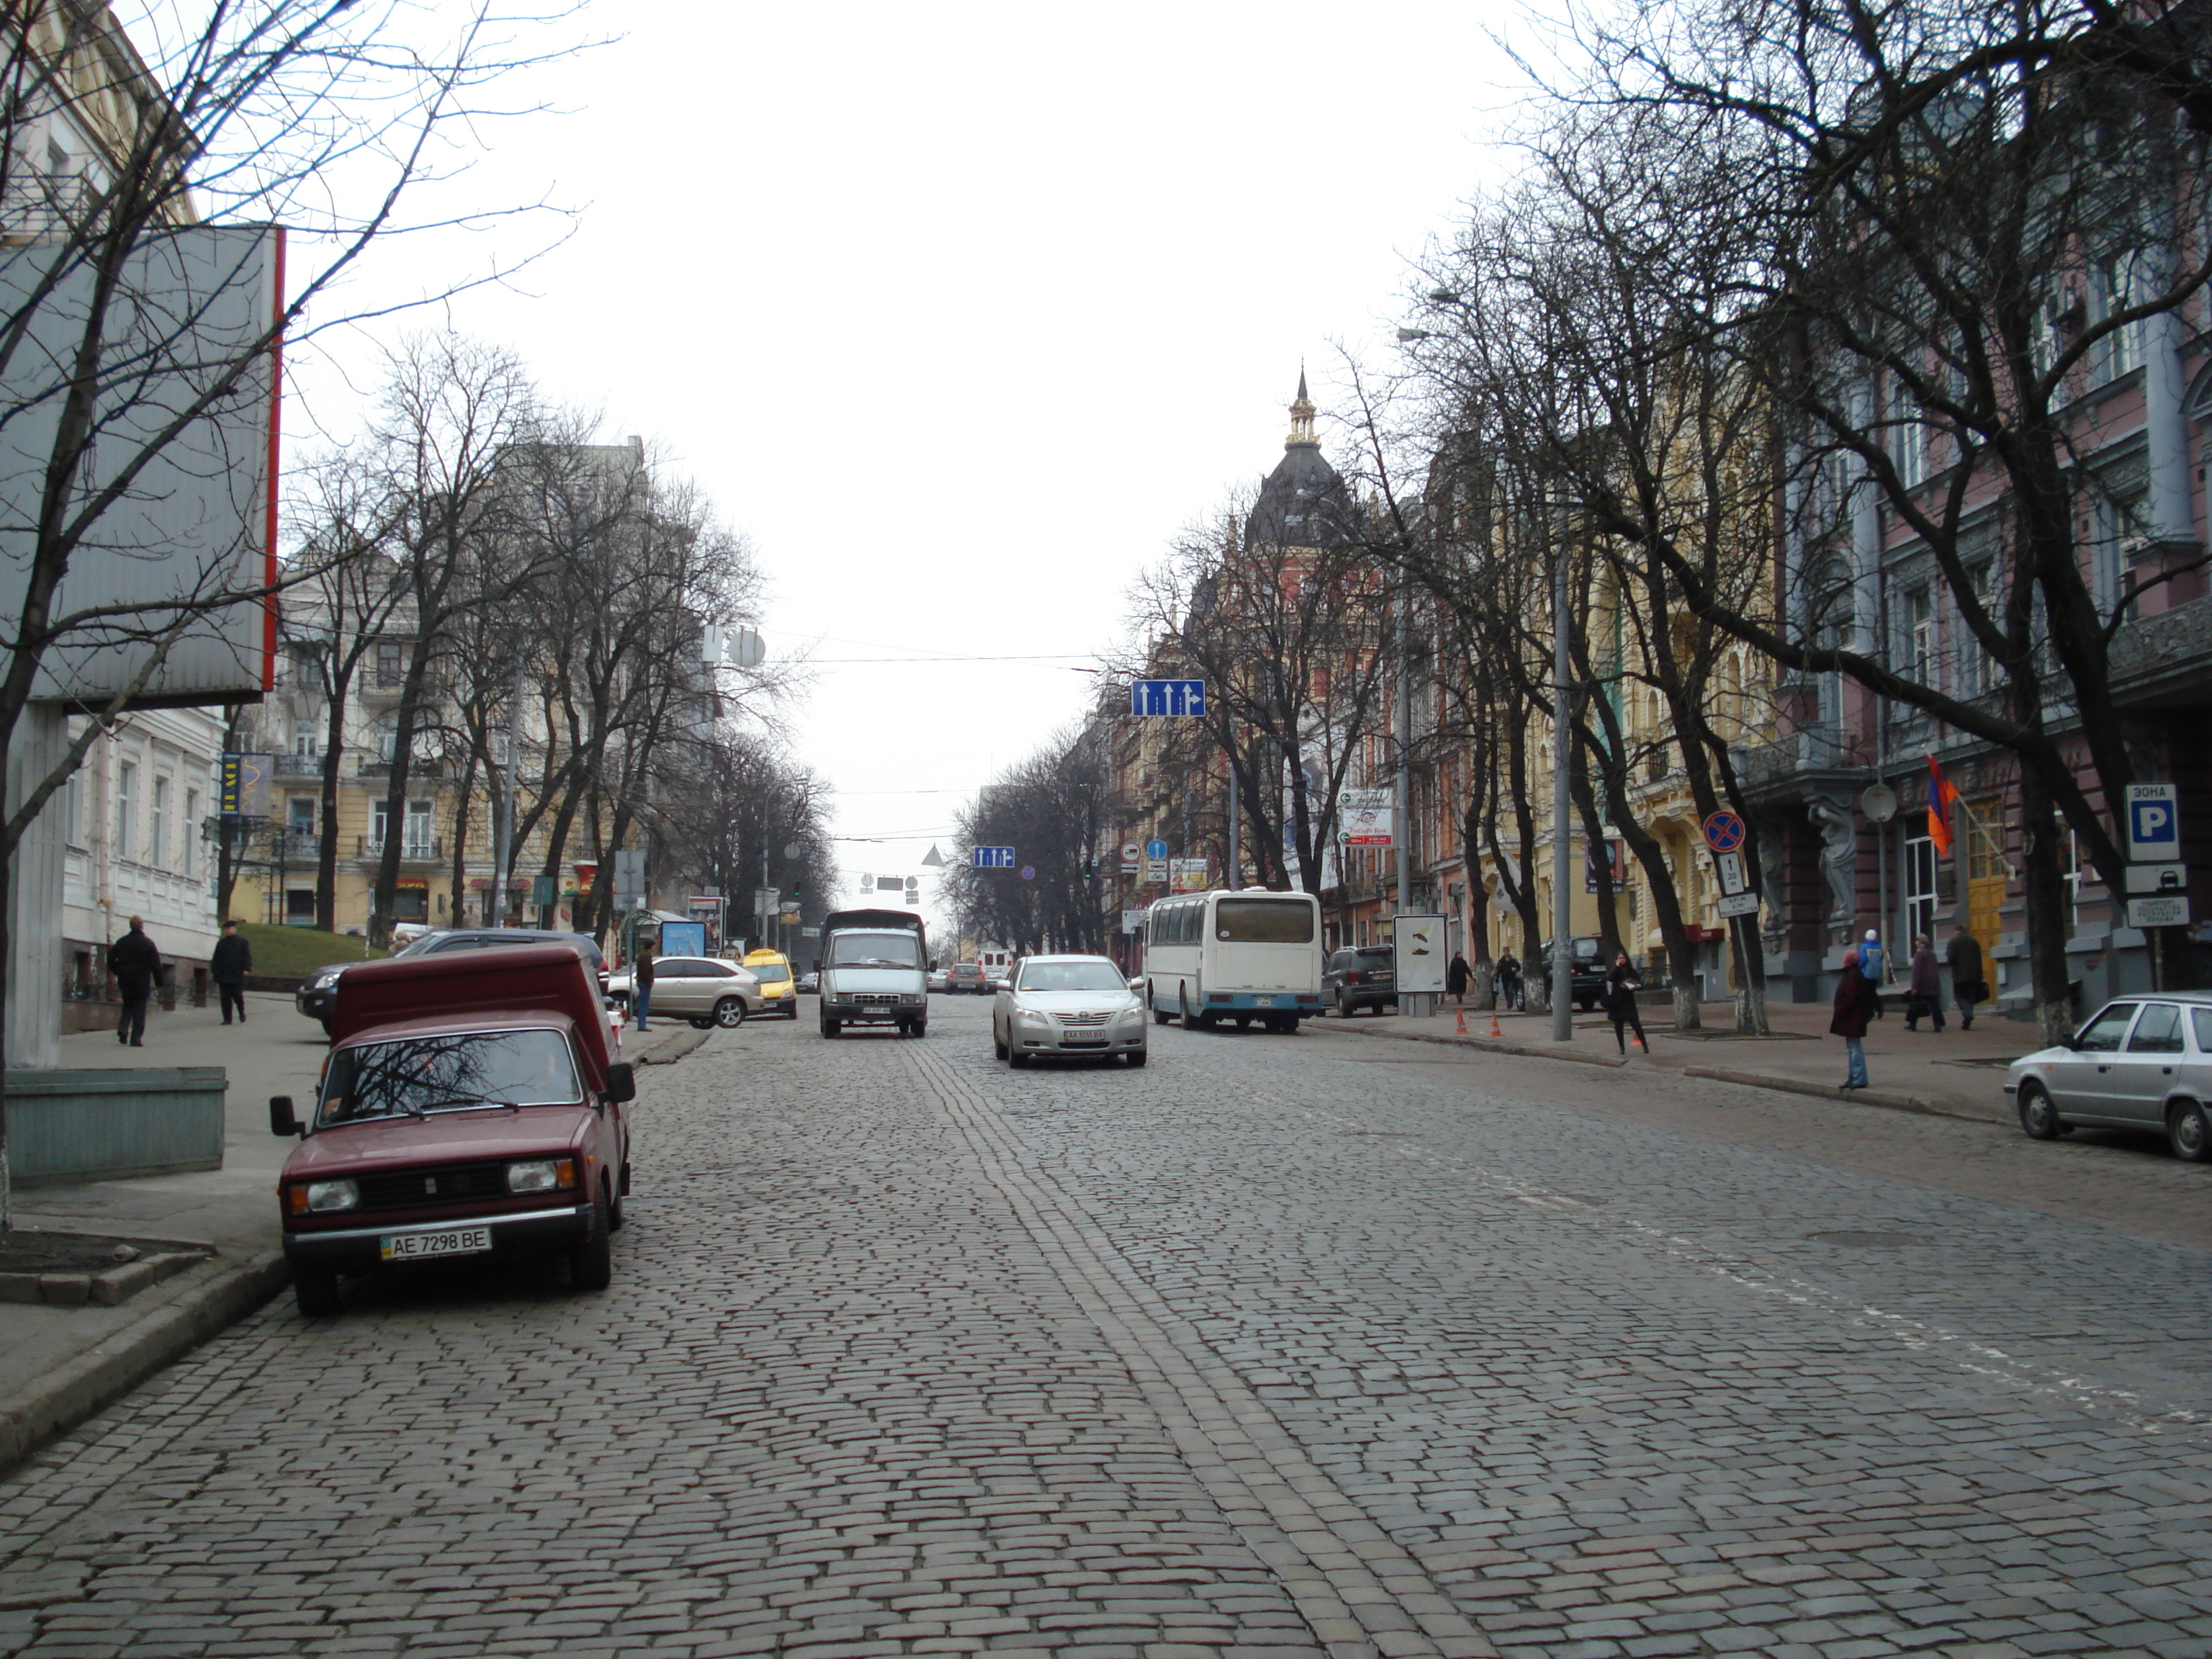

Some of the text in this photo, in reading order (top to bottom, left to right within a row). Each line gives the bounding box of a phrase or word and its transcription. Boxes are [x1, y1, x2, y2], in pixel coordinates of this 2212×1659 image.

[2134, 787, 2166, 798] ЗОНА
[2140, 806, 2167, 837] P
[393, 1231, 486, 1255] AE 7298 BE
